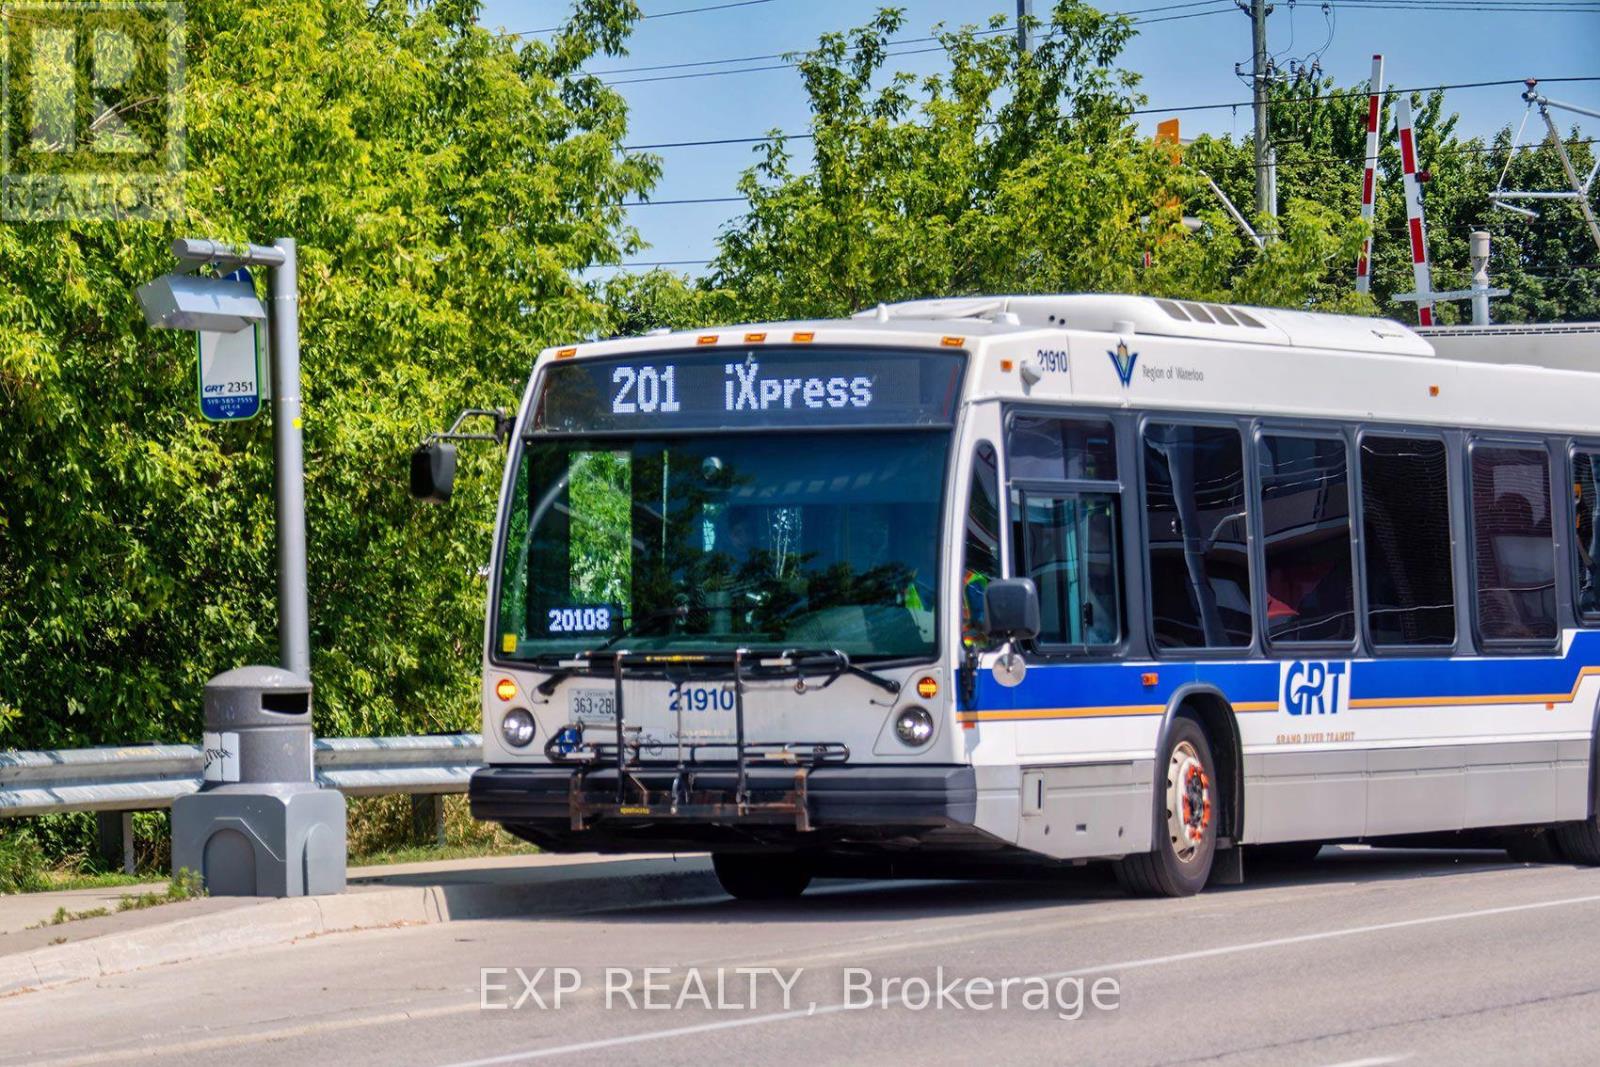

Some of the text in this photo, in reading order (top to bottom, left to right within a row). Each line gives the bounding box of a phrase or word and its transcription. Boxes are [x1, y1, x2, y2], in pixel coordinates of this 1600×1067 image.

[1142, 365, 1204, 382] Region of Waterloo
[204, 381, 253, 393] GRT 2351
[612, 363, 873, 413] 201 iXpress
[549, 608, 609, 631] 20108
[1285, 660, 1346, 715] GRT
[668, 688, 734, 711] 21910
